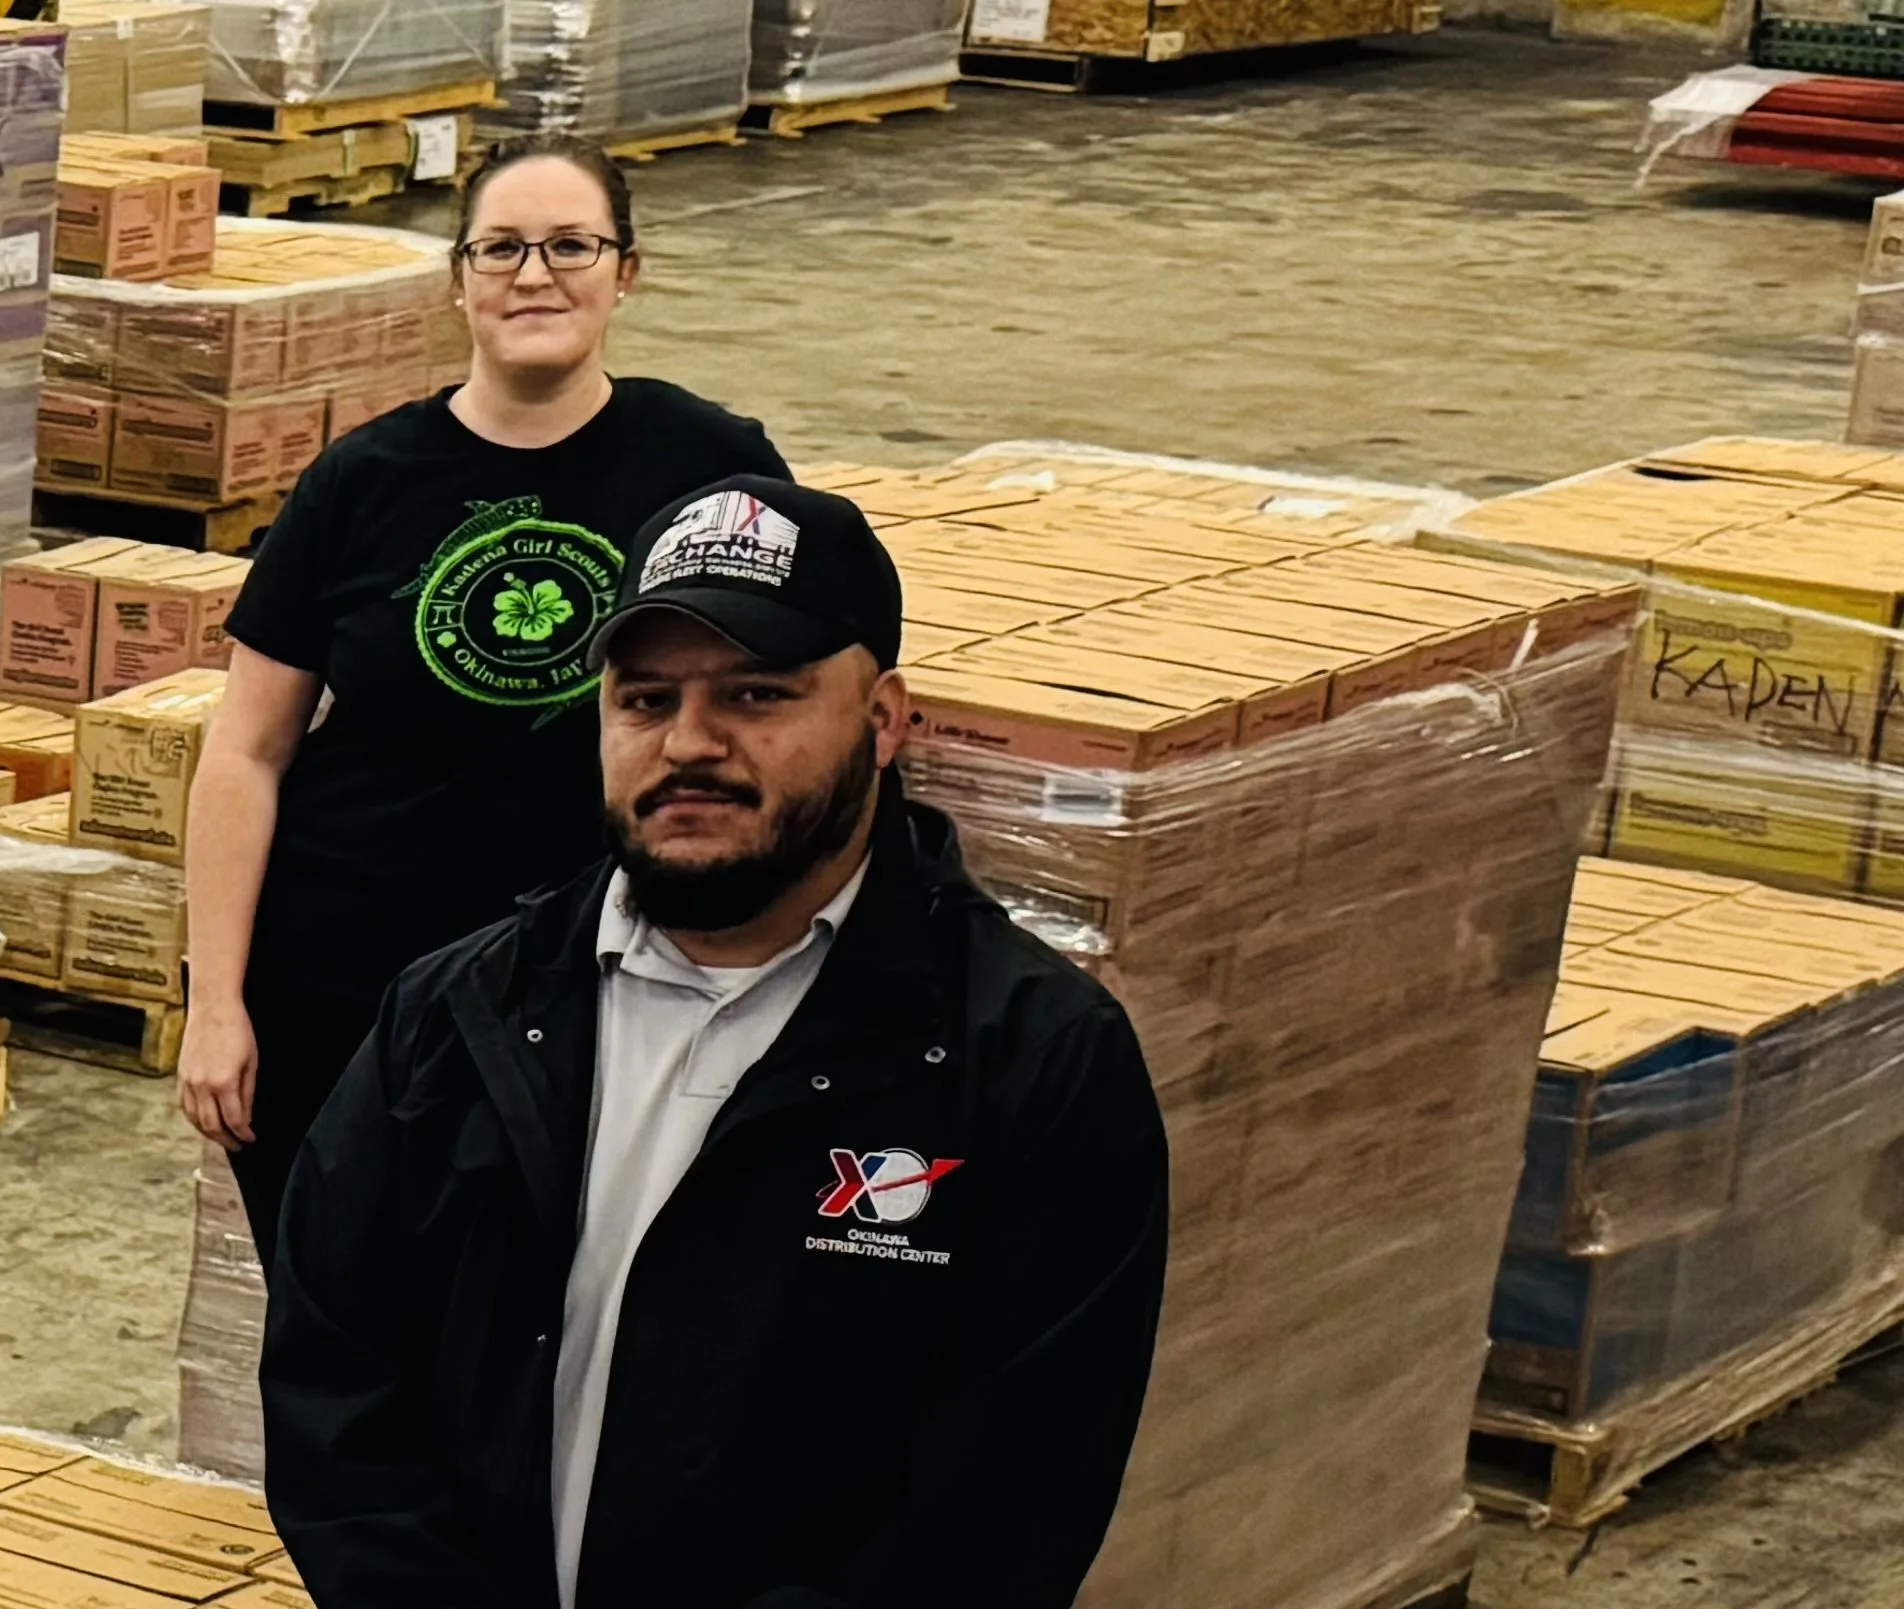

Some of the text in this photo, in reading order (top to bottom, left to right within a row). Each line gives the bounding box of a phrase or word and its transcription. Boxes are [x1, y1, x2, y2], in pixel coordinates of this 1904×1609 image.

[441, 544, 509, 597] Kadena
[513, 538, 554, 555] Girl
[556, 542, 612, 588] Scouts
[706, 565, 783, 587] OPERATIONS
[549, 658, 584, 686] Jap
[805, 1236, 951, 1265] DISTRIBUTION CENTER
[847, 1228, 910, 1247] OKINAWA
